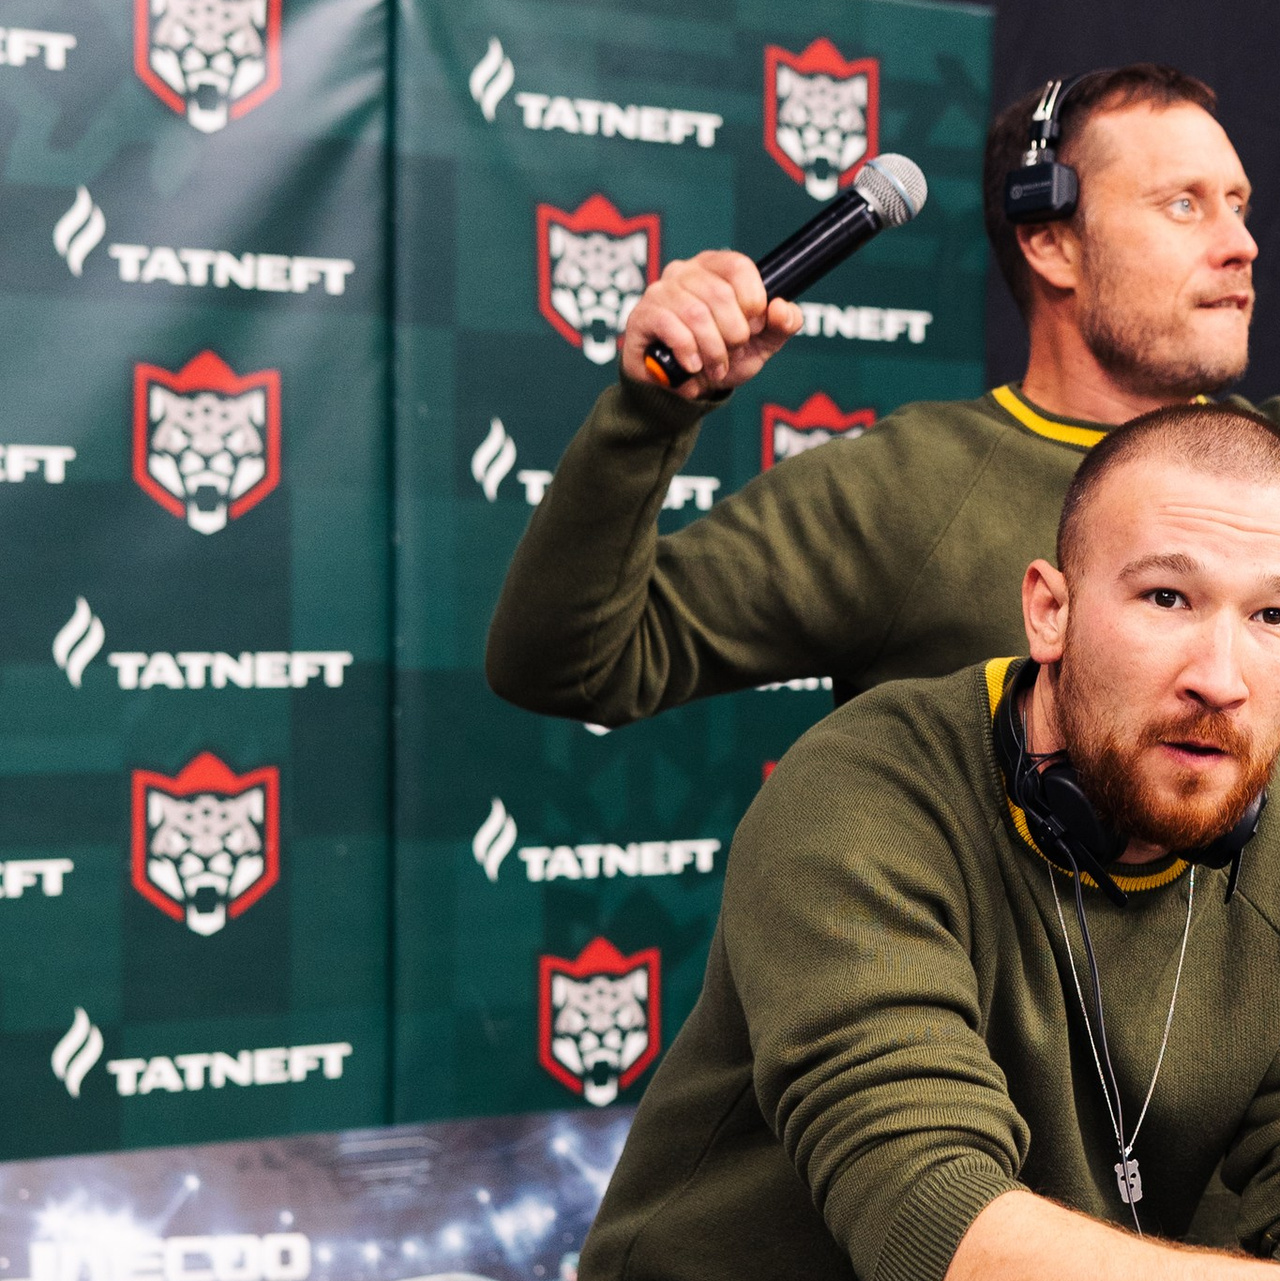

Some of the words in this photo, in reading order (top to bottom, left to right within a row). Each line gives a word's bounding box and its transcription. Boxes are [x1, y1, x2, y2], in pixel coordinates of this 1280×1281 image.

[515, 91, 723, 148] TATNEFT
[107, 242, 355, 296] TATNEFT
[797, 302, 933, 343] TNEFT
[107, 650, 354, 690] TATNEFT
[518, 838, 721, 882] TATNEFT
[106, 1041, 353, 1096] TATNEFT
